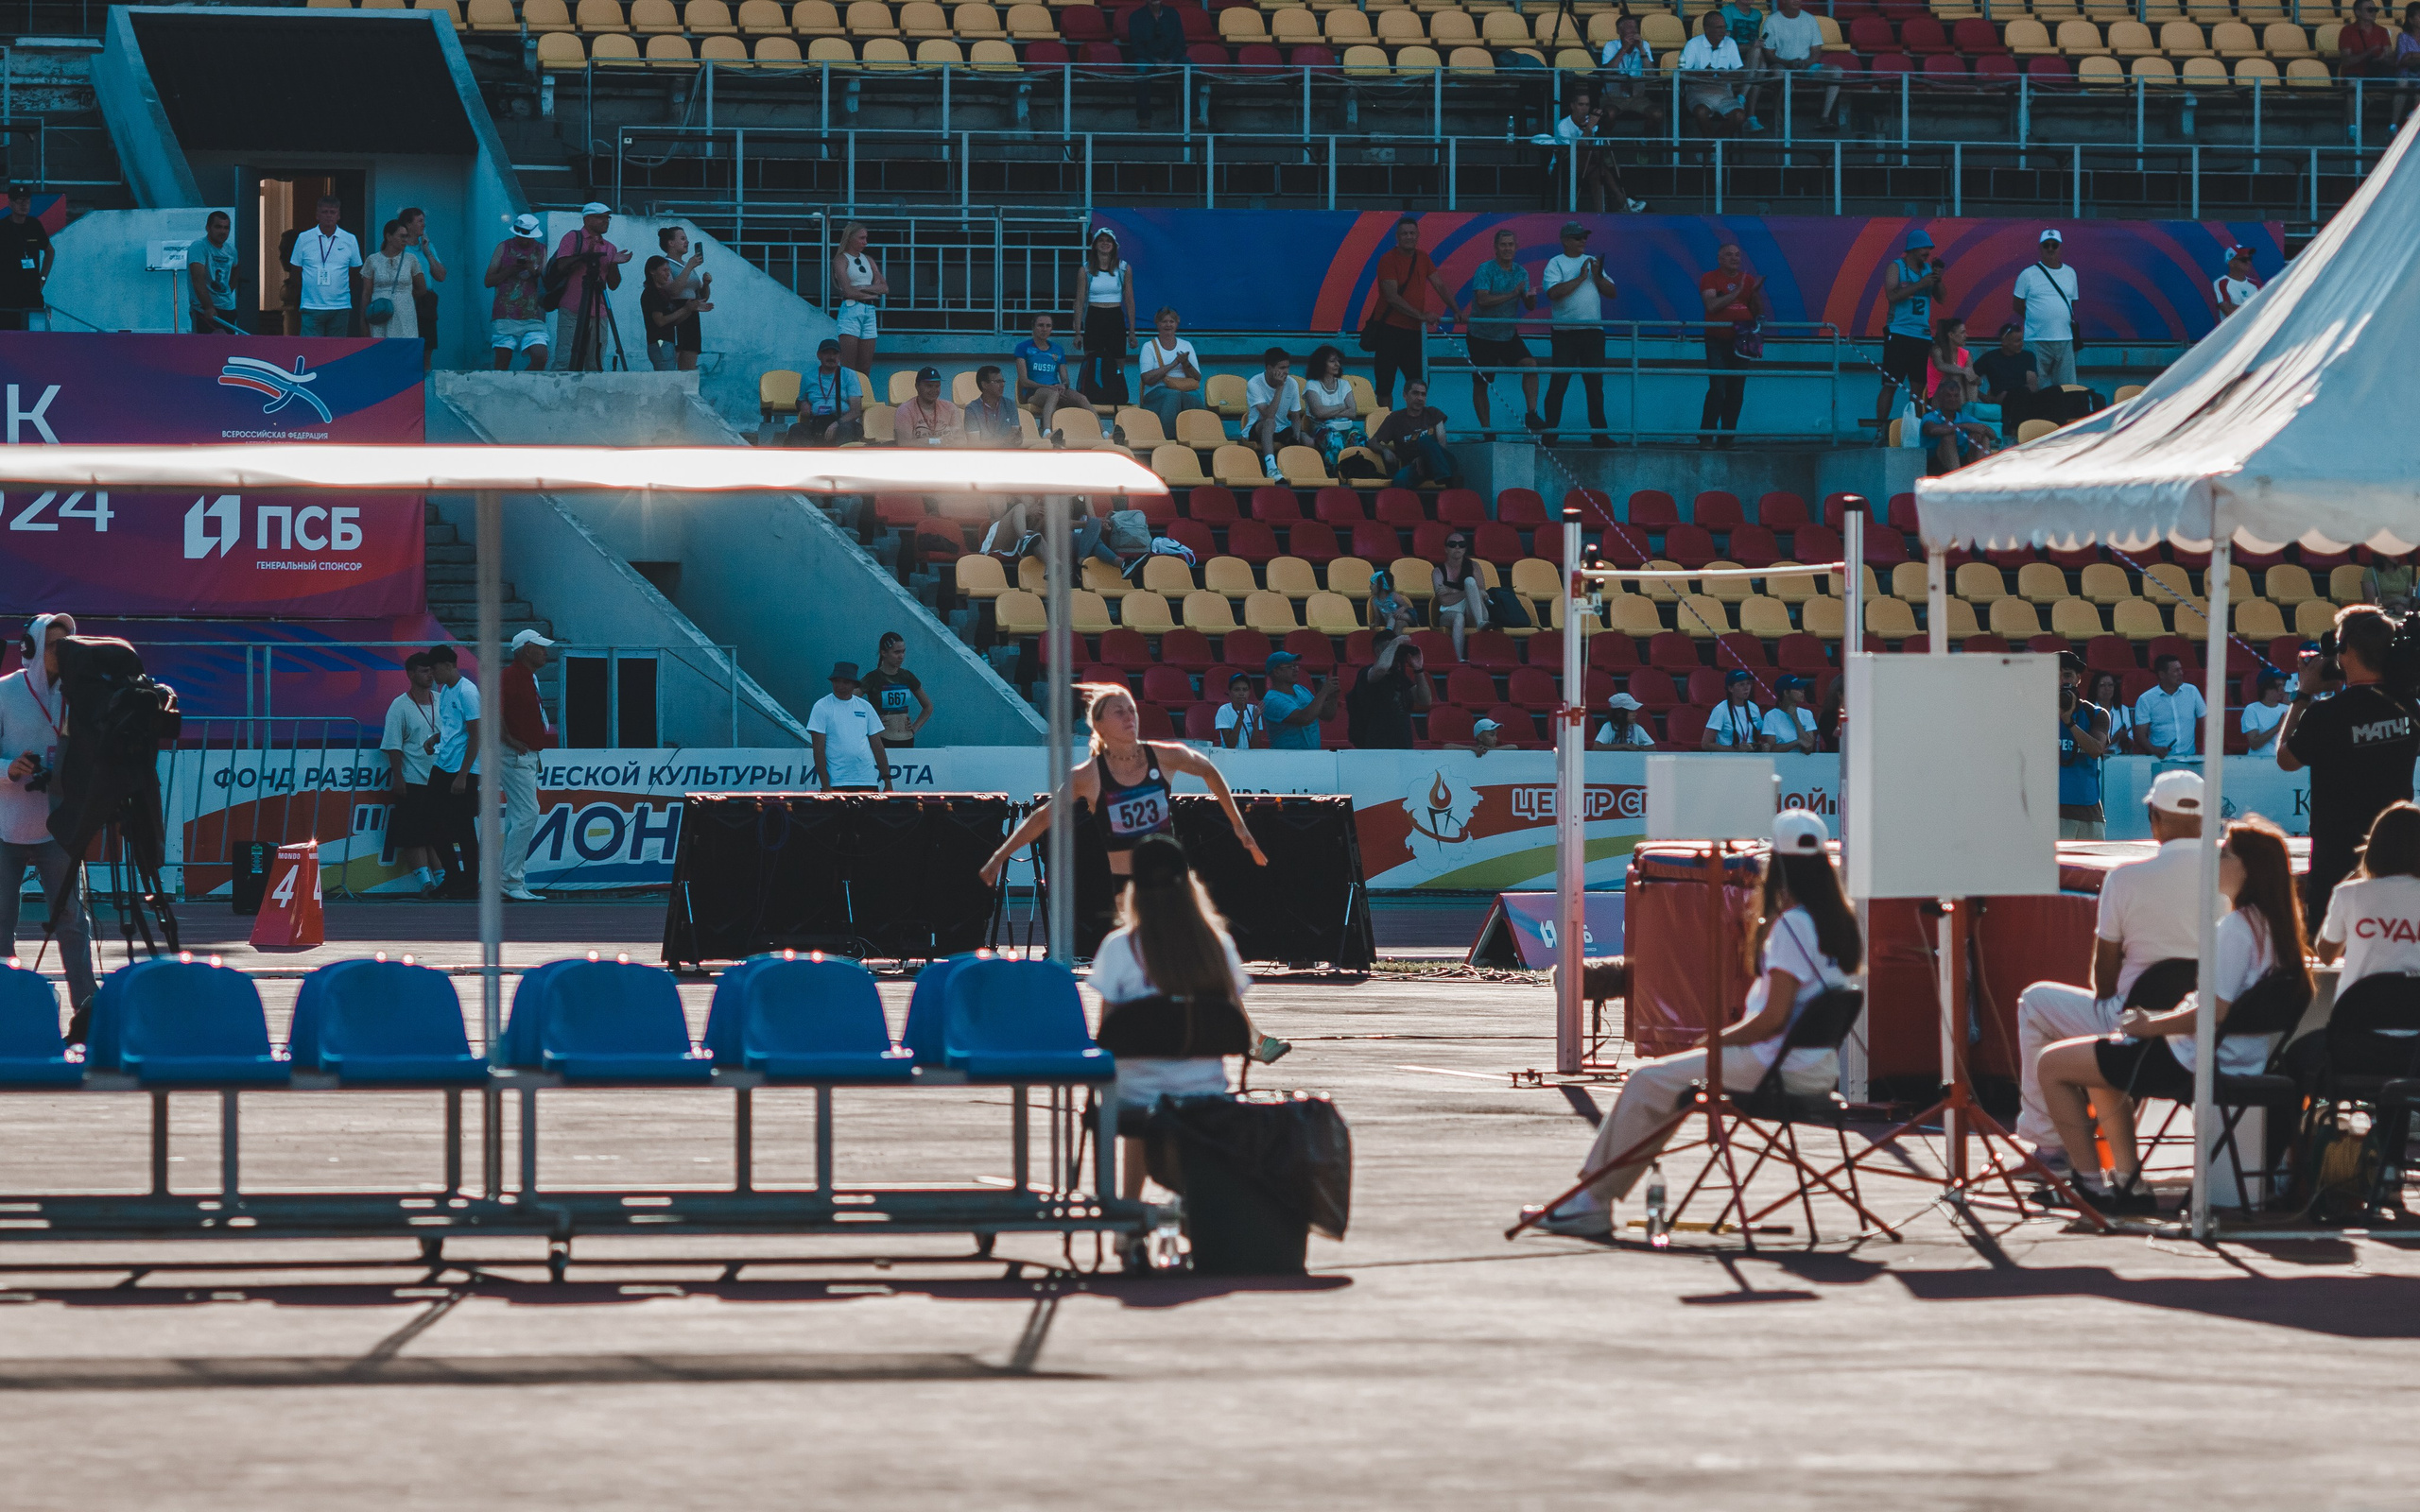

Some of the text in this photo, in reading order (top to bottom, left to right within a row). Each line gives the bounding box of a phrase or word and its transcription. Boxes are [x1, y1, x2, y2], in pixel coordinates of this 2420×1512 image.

[222, 429, 328, 440] ВСЕРОССИЙСКАЯ ФЕДЕРАЦИЯ
[0, 490, 114, 531] 24
[257, 506, 363, 551] ПСБ
[256, 559, 362, 572] ГЕНЕРАЛЬНЫЙ СПОНСОР
[888, 692, 907, 706] 667
[214, 767, 296, 791] ФОНД
[648, 765, 791, 786] КУЛЬТУРЫ
[1119, 799, 1160, 829] 523
[1512, 788, 1615, 820] ЦЕТР
[271, 864, 300, 908] 4
[2356, 917, 2420, 944] СУД
